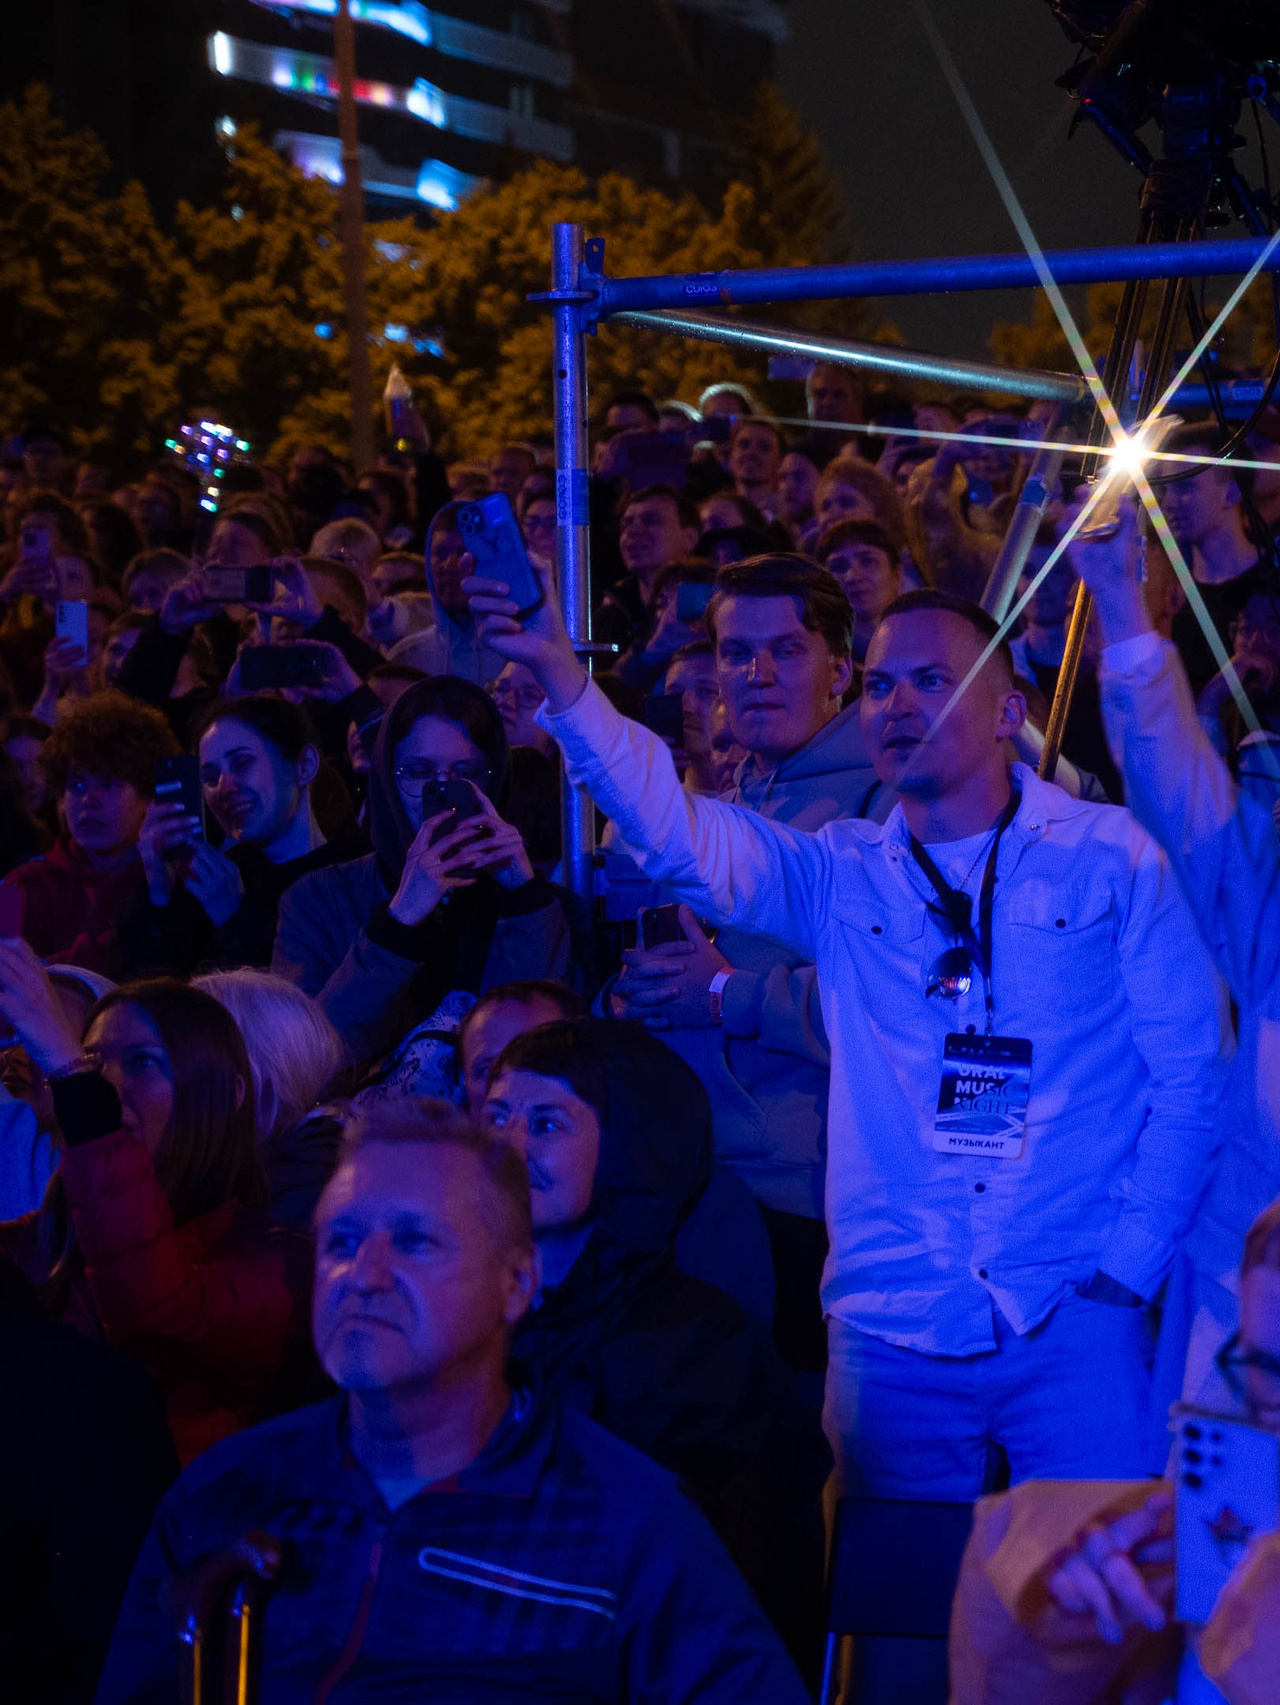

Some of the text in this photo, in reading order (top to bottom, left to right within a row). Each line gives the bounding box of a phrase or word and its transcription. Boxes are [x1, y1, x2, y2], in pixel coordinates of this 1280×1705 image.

[955, 1079, 1015, 1098] MUSIC
[954, 1097, 1010, 1114] NIGHT
[949, 1138, 1004, 1149] МУЗЫКАНТ
